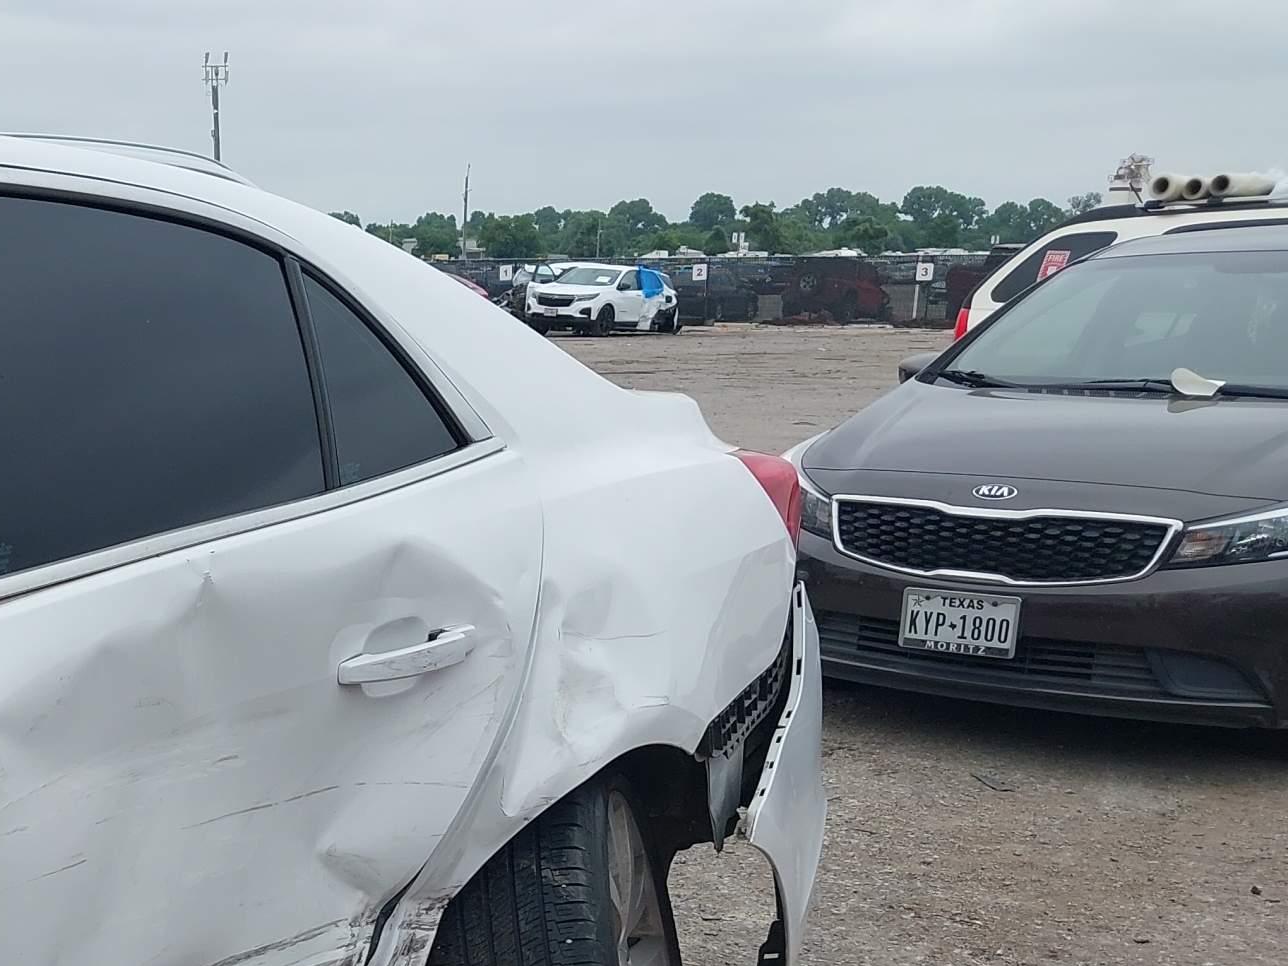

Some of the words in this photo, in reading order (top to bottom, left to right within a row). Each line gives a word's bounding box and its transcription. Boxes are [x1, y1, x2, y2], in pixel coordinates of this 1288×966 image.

[503, 269, 508, 277] 1
[696, 267, 704, 277] 2
[920, 267, 929, 277] 3
[978, 485, 1009, 497] KIA
[940, 597, 985, 610] TEXAS
[924, 640, 987, 655] MORITZ
